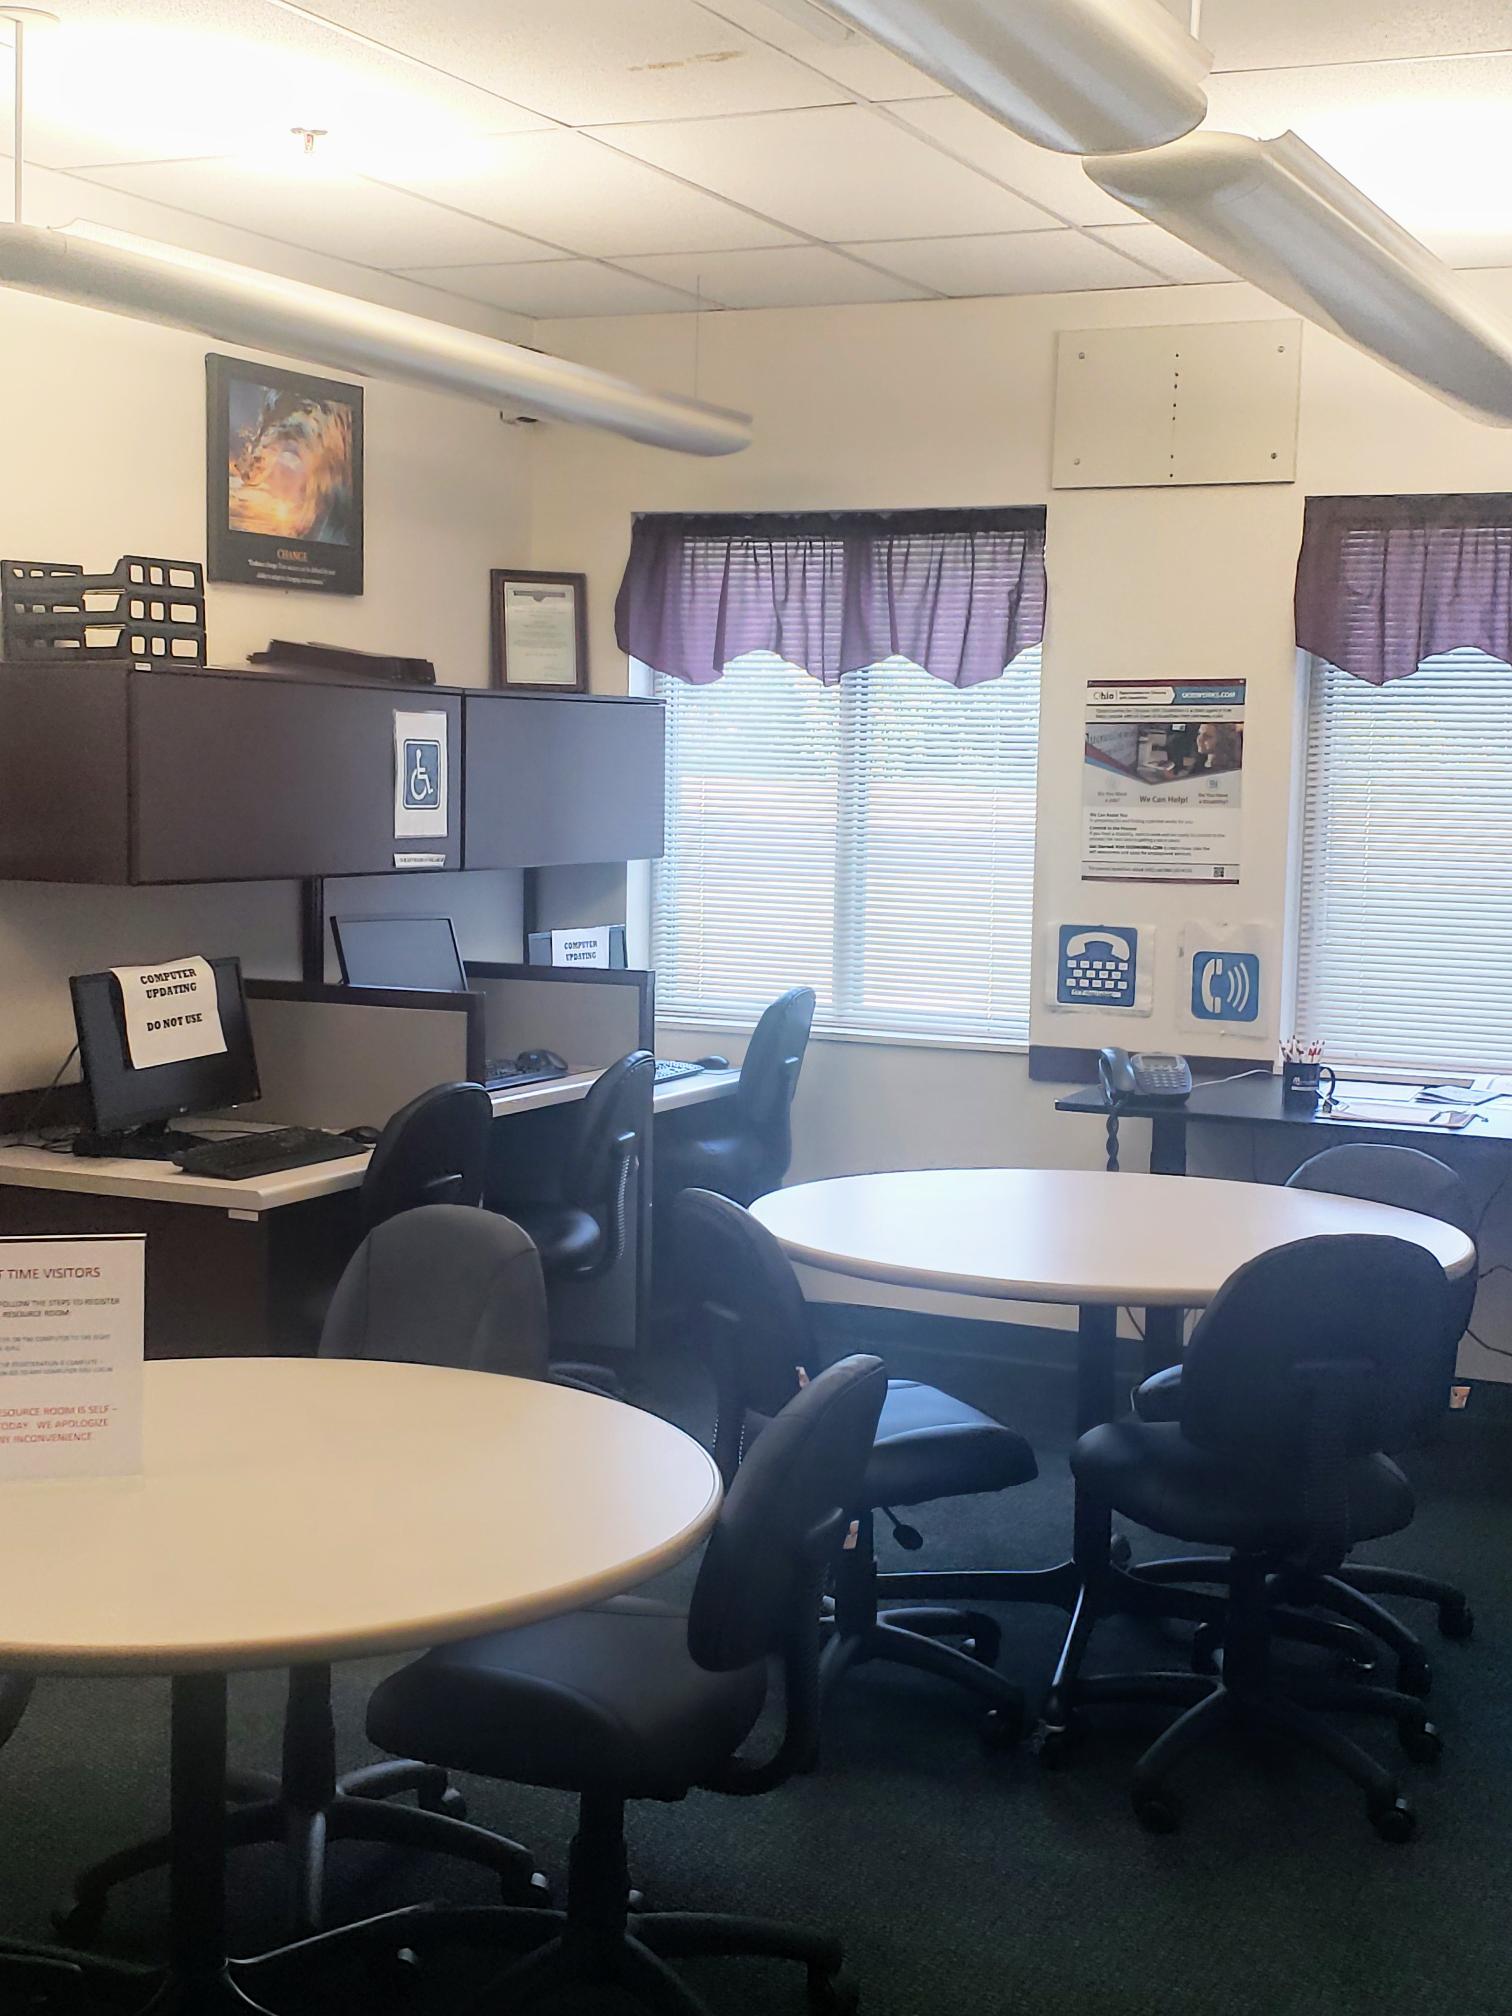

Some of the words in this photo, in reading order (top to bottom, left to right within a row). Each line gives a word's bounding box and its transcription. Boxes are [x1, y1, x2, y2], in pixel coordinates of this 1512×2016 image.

[277, 548, 307, 561] CHANGE
[1167, 796, 1189, 804] Help!
[564, 941, 598, 950] COMPUTER
[565, 952, 597, 961] UPDATING
[140, 969, 197, 984] COMPUTER
[146, 982, 197, 999] UPDATING
[146, 1021, 161, 1031] DO
[163, 1016, 184, 1029] NOT
[185, 1013, 203, 1024] USE
[8, 1268, 40, 1279] TIME
[43, 1267, 101, 1279] VISITORS
[0, 1407, 40, 1417] ESOURCE
[43, 1407, 75, 1416] ROOM
[88, 1405, 110, 1414] SELF
[55, 1418, 108, 1428] APOLOGIZE
